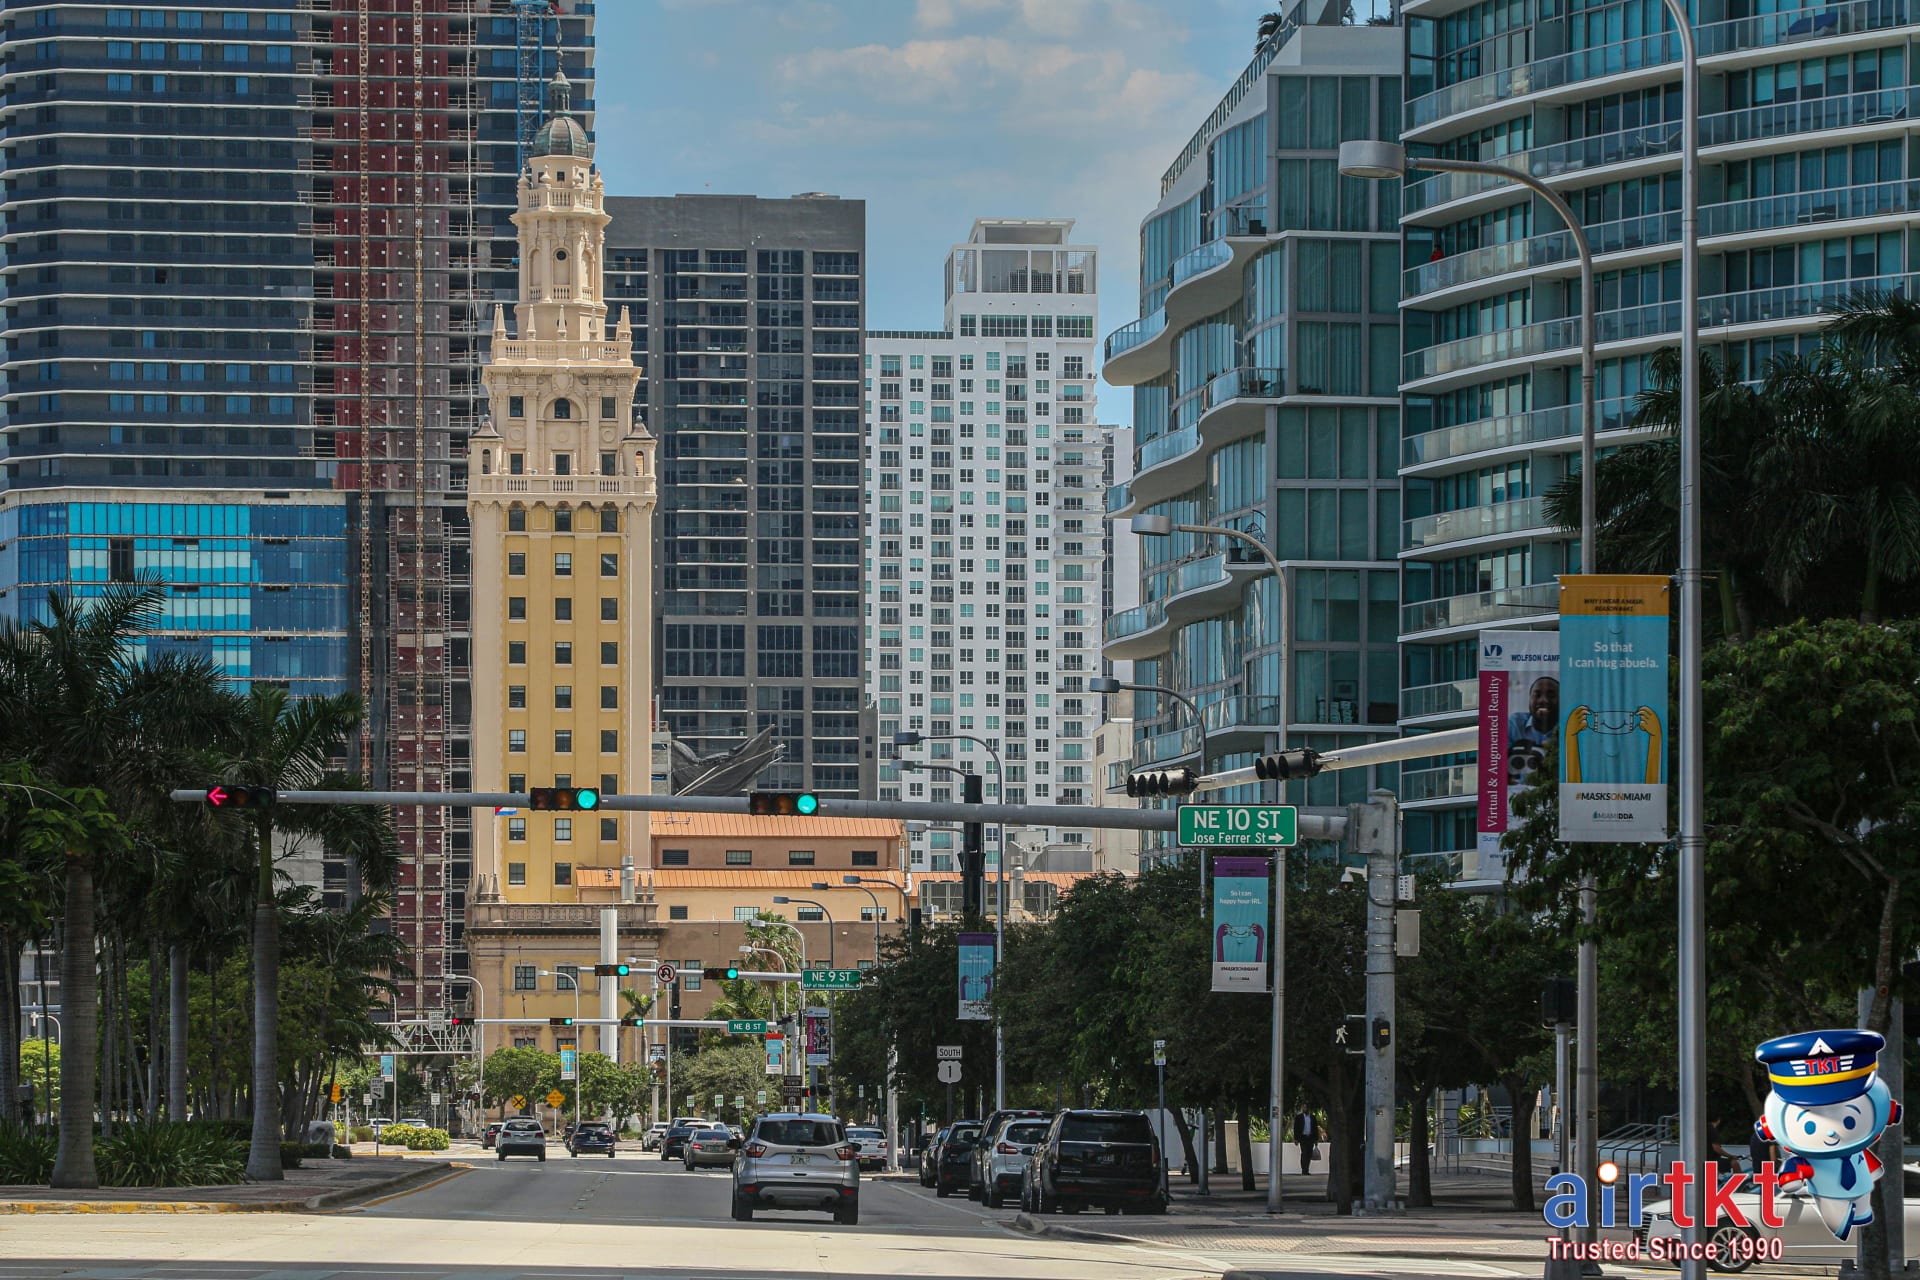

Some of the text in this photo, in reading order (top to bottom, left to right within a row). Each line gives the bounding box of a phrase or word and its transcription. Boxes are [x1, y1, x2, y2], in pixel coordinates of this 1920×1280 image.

[1594, 641, 1632, 652] So that
[1568, 657, 1659, 670] I can hug abuela.
[1488, 676, 1502, 712] Reality
[1488, 715, 1502, 775] Augmented
[1488, 777, 1498, 786] &
[1576, 792, 1651, 800] #MASKSONMIAMI
[1488, 790, 1498, 828] Virtual
[1194, 808, 1280, 830] NE 10 ST
[1191, 832, 1266, 844] Jose Ferrer St
[812, 971, 851, 982] NE 9 ST
[940, 1048, 960, 1056] SOUTH
[948, 1065, 951, 1078] 1
